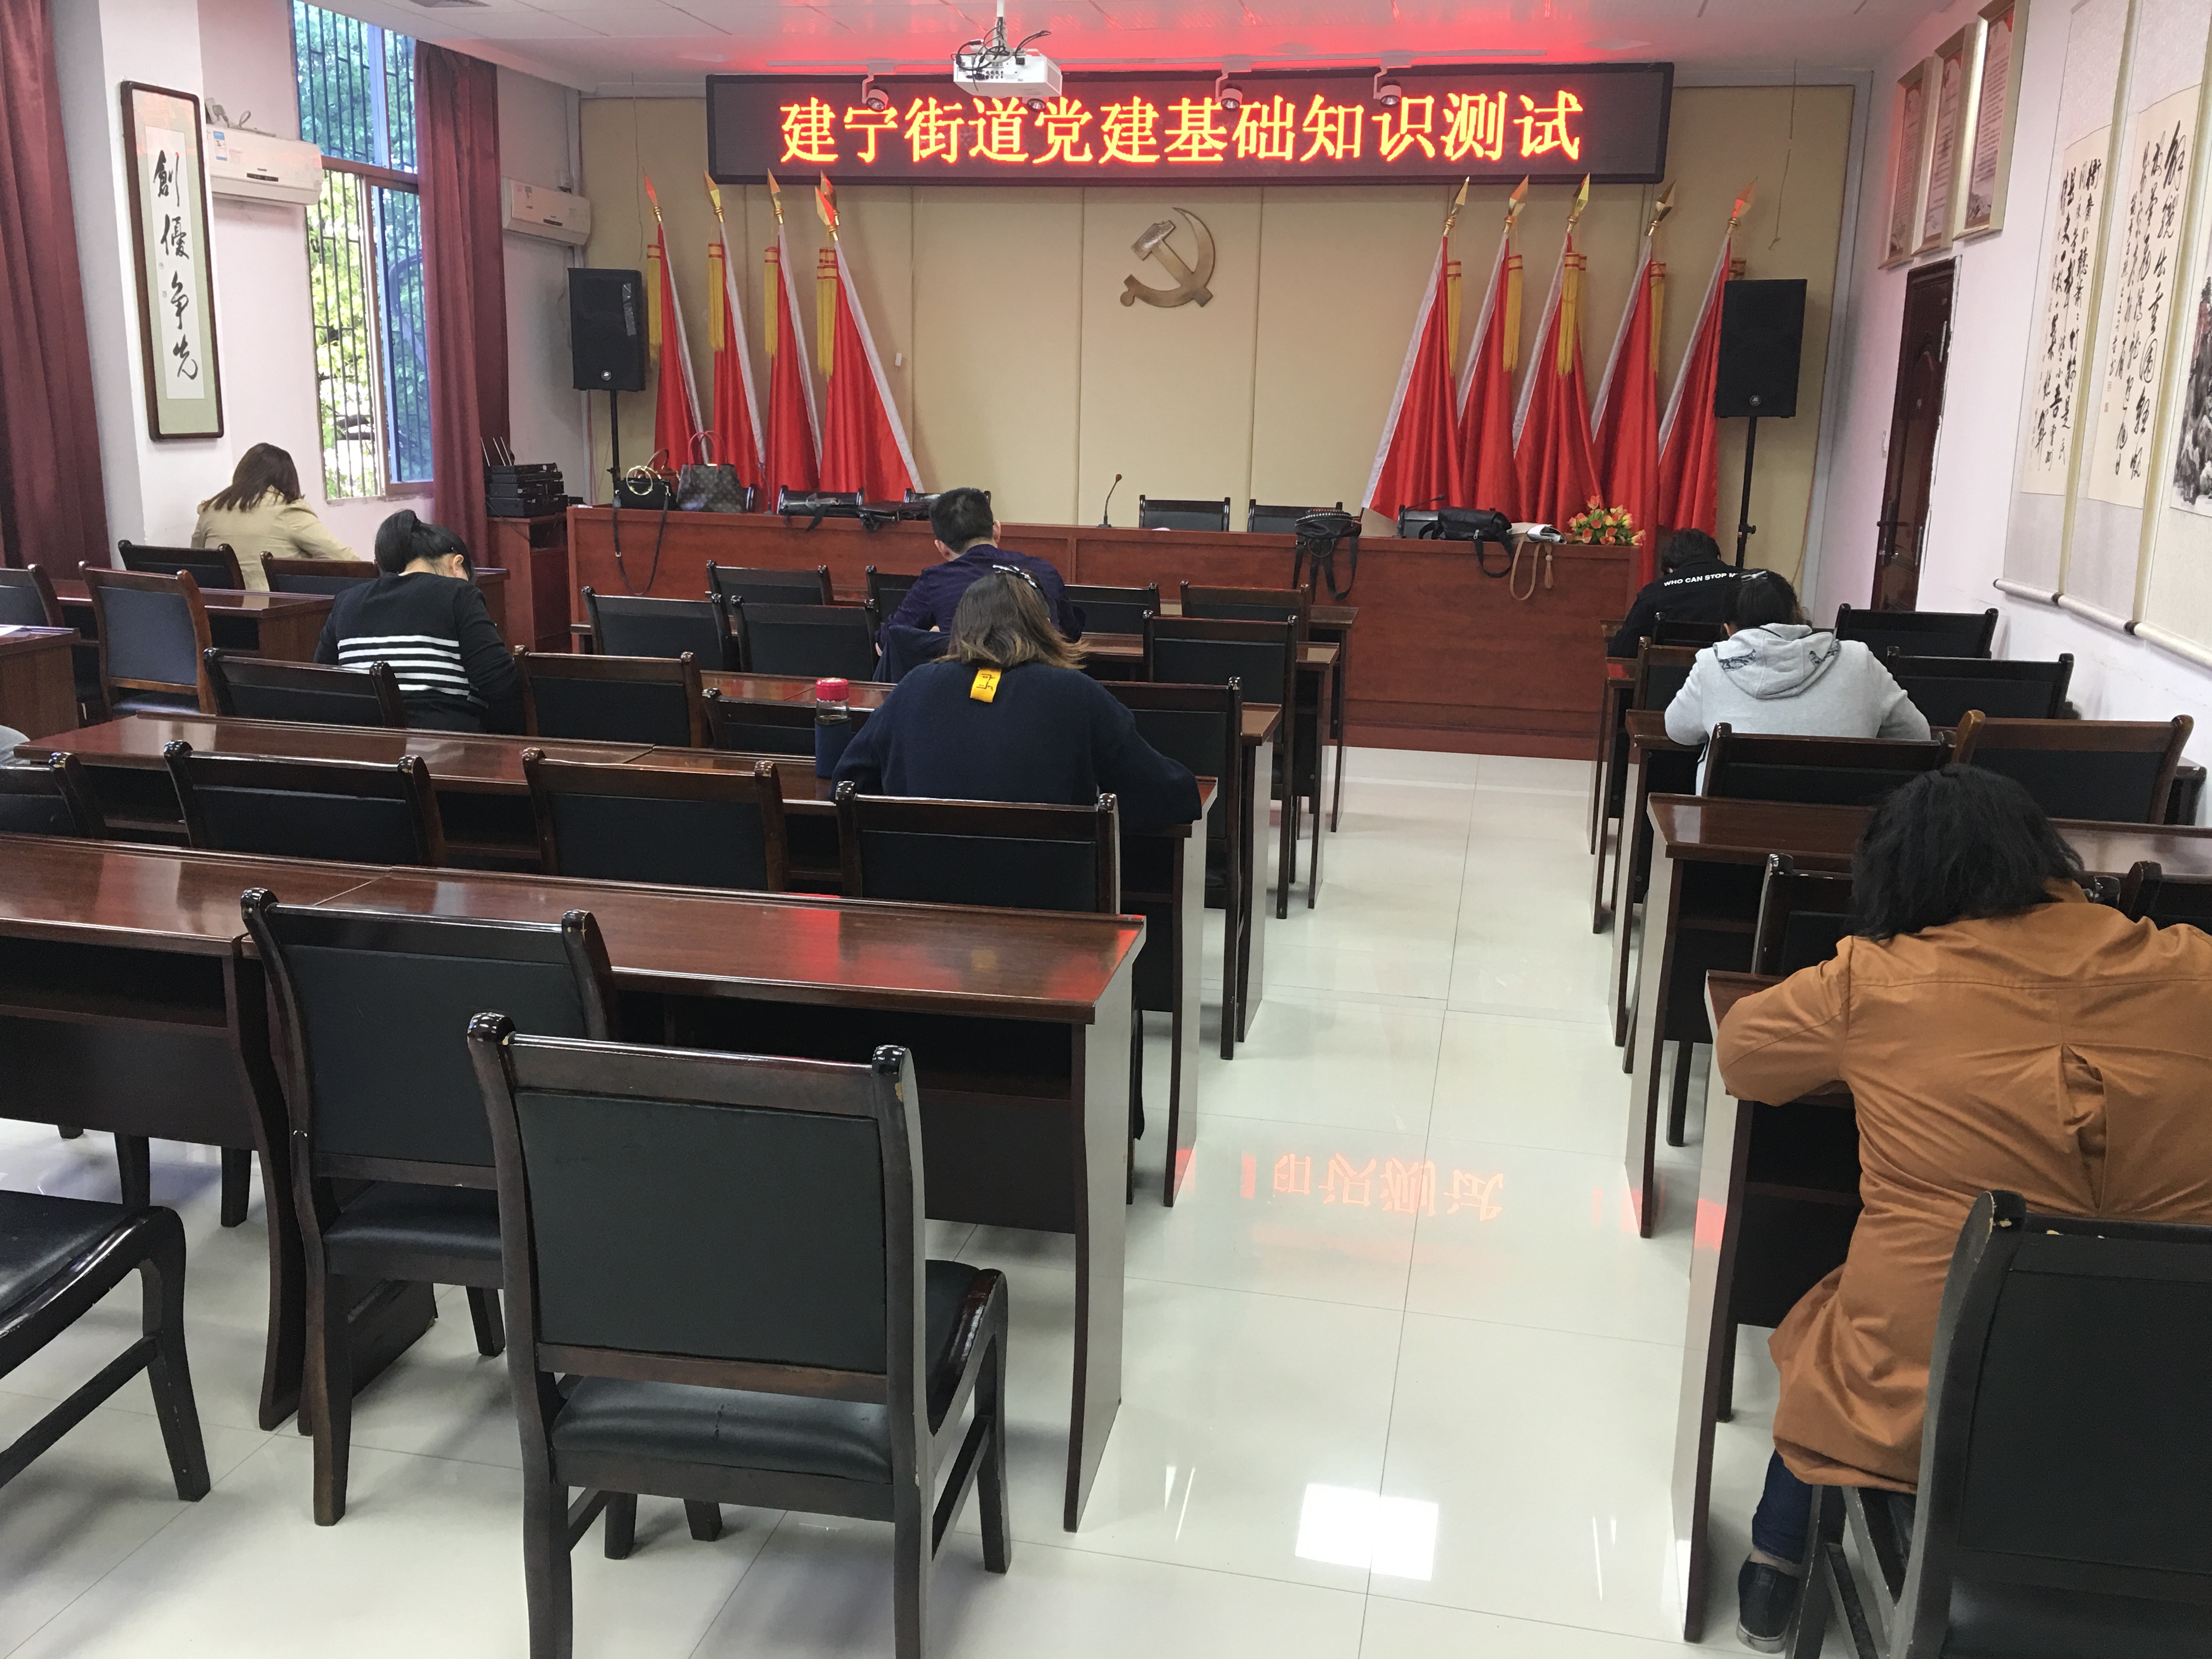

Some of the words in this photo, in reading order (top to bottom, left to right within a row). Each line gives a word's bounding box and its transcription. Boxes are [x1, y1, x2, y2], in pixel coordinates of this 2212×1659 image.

[780, 90, 1584, 163] 建宁街道党建基础知识测试
